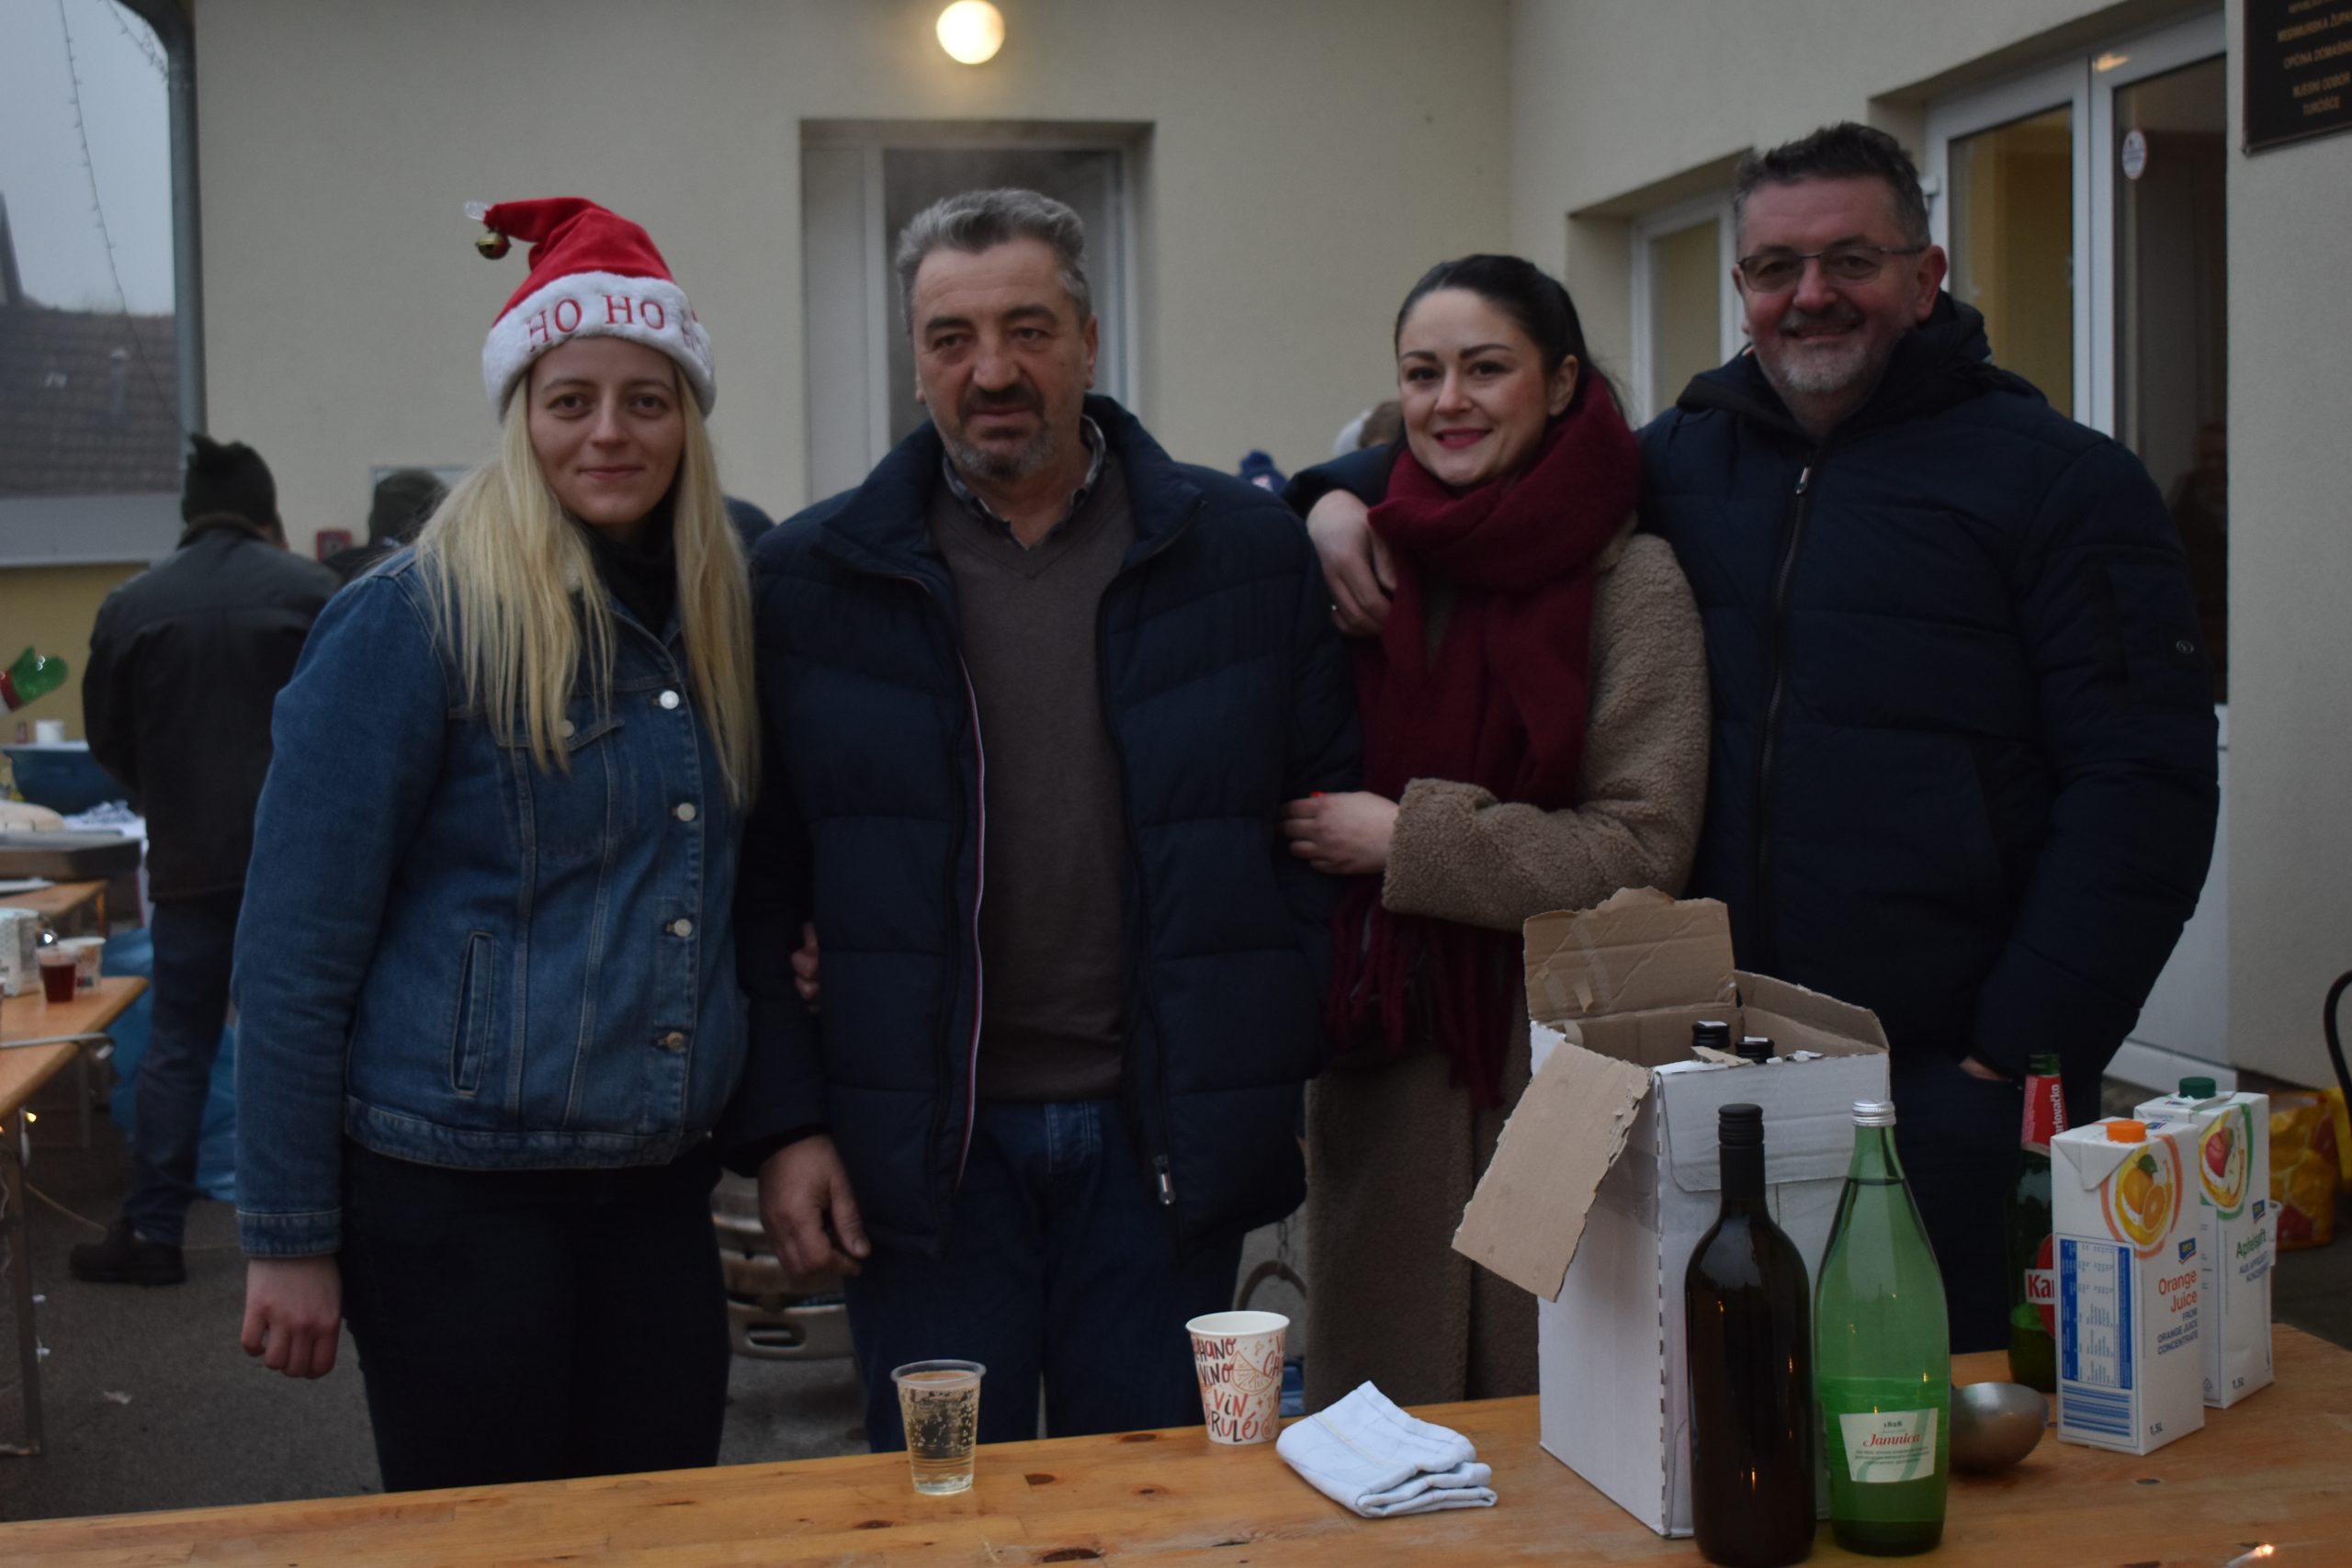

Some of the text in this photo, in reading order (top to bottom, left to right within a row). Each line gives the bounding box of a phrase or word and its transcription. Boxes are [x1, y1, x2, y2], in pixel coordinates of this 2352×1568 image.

[527, 293, 665, 353] HO HO
[2158, 1269, 2197, 1295] Orange
[2170, 1290, 2198, 1313] Juice
[1862, 1432, 1921, 1448] Jamnica
